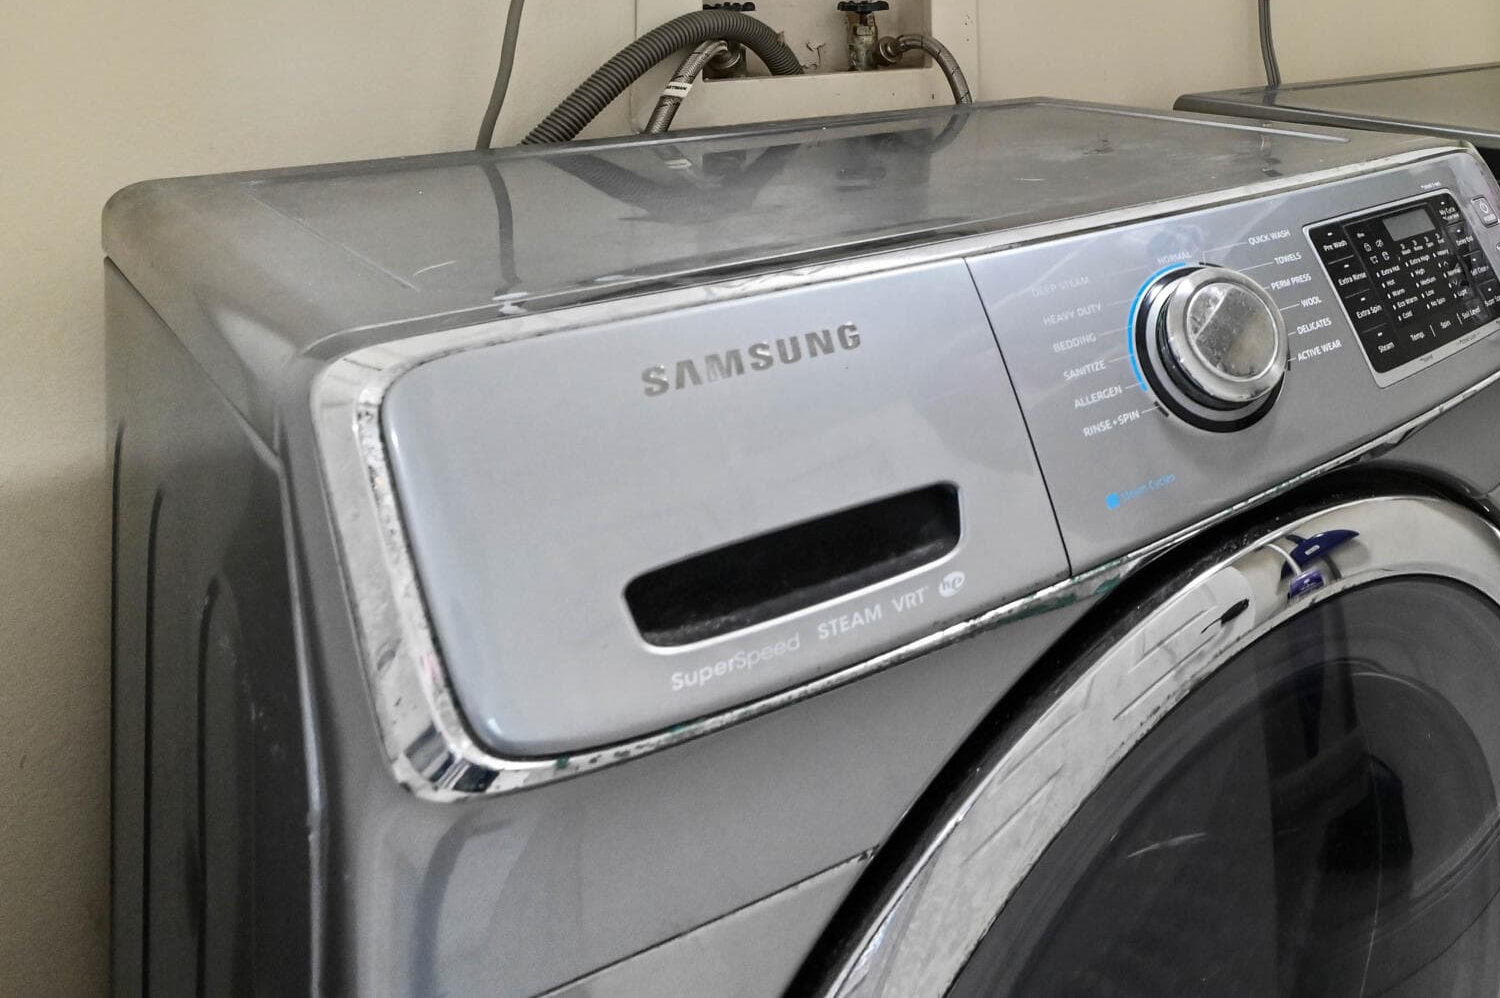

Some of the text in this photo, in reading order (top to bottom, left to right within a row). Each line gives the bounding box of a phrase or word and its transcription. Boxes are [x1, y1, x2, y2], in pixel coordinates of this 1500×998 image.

[1248, 229, 1291, 245] QUICK WASH
[1157, 251, 1192, 264] NORMAL
[1274, 252, 1302, 265] TOWELS
[1271, 273, 1312, 290] PERM PRESS
[1301, 296, 1322, 307] WOOL
[1043, 303, 1101, 325] HEAVY DUTY
[1297, 317, 1332, 335] DELICATES
[1052, 333, 1097, 352] BEDDING
[1297, 340, 1341, 361] ACTIVE WEAR
[641, 323, 861, 398] SAMSUNG
[1063, 360, 1107, 381] SANITIZE
[1074, 385, 1122, 409] ALLERGEN
[671, 632, 800, 691] SuperSpeed
[817, 604, 882, 640] STEAM
